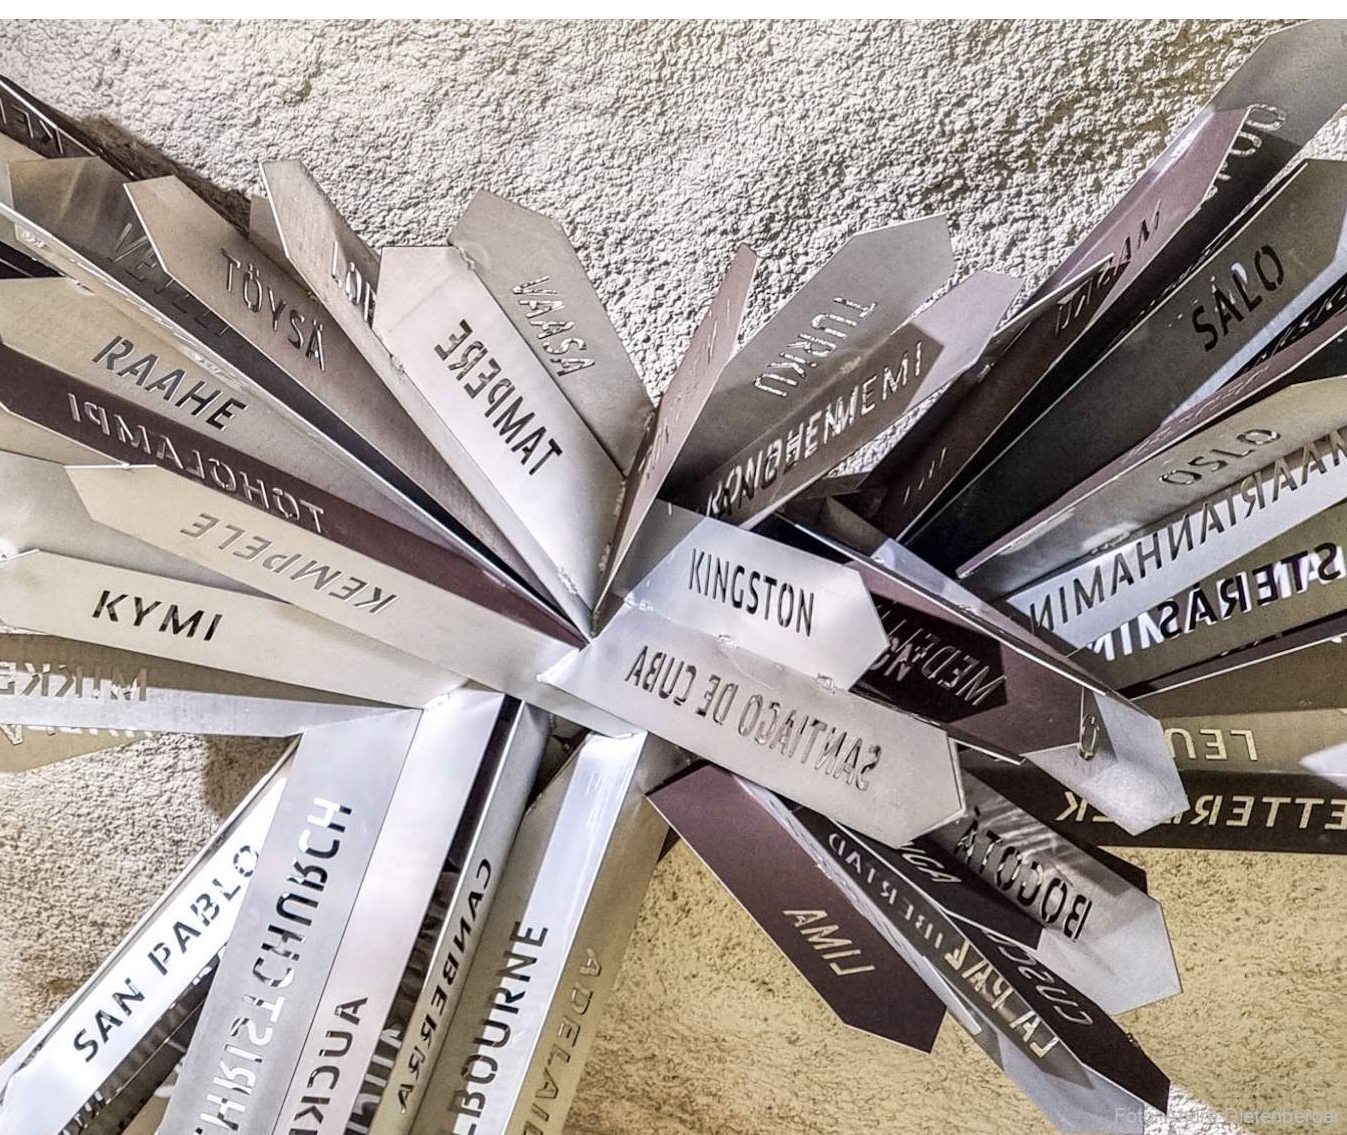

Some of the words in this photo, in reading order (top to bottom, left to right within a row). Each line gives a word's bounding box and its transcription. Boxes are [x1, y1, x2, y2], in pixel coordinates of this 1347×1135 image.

[219, 245, 326, 373] TÖYSÄ
[511, 274, 597, 379] VAASA
[753, 296, 879, 399] TURKU
[1191, 243, 1286, 352] SALO
[92, 334, 248, 432] RAAHE
[1158, 428, 1282, 486] OSLO
[92, 588, 224, 643] KYMI
[688, 547, 816, 639] KINGSTON
[72, 976, 146, 1063] SAN
[146, 843, 260, 977] PABLO
